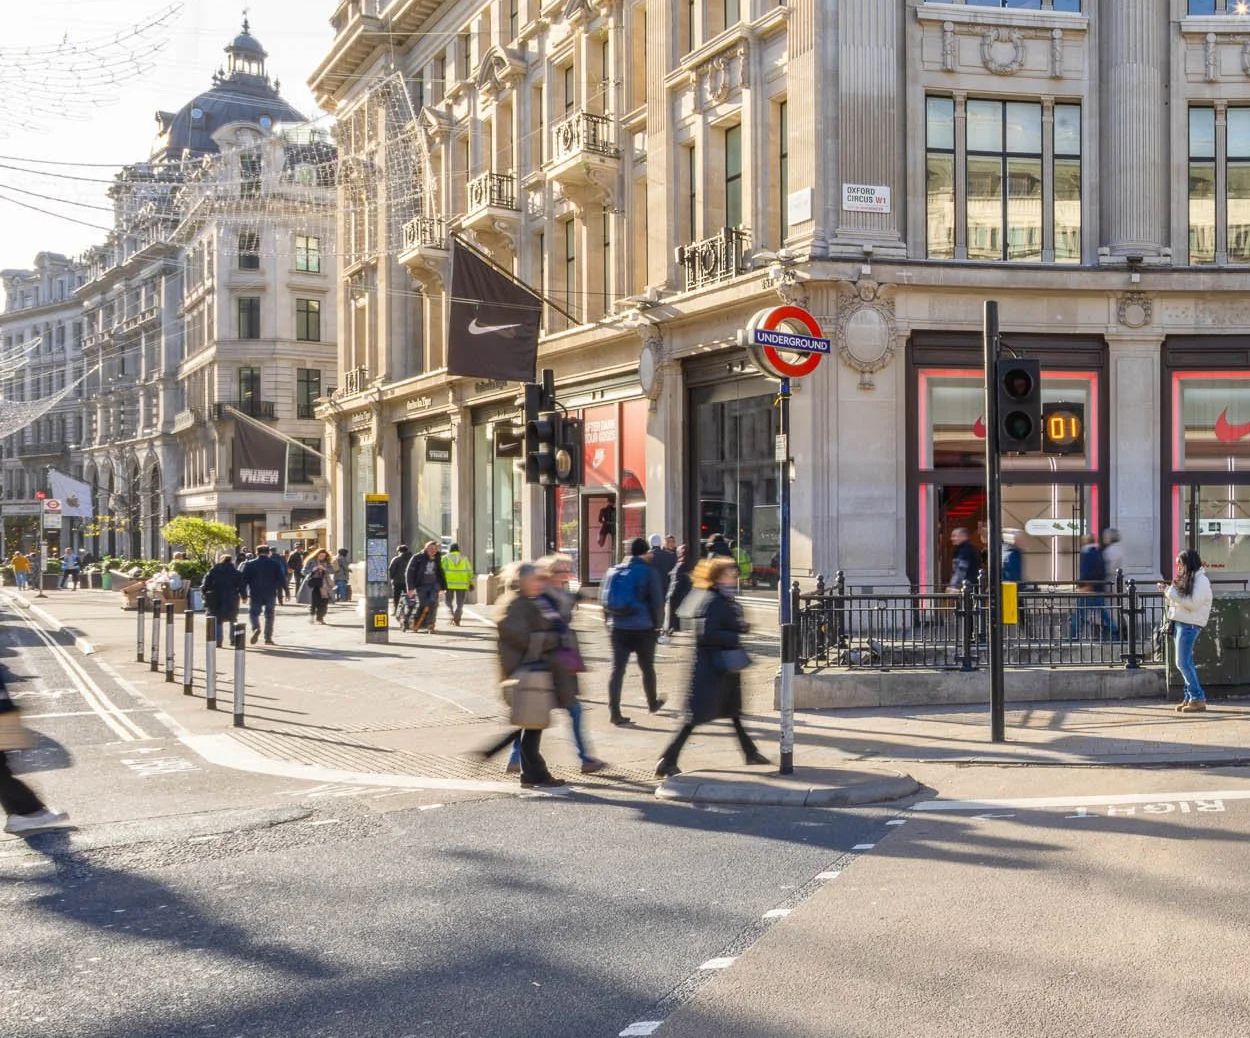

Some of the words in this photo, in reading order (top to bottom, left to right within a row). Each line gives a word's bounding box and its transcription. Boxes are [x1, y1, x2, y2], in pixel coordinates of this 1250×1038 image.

[847, 186, 876, 196] OXFORD
[847, 195, 874, 204] CIRCUS
[875, 196, 887, 205] W1
[757, 332, 828, 351] UNDERGROUND
[1051, 417, 1077, 439] 01
[1065, 799, 1226, 819] RIGHT
